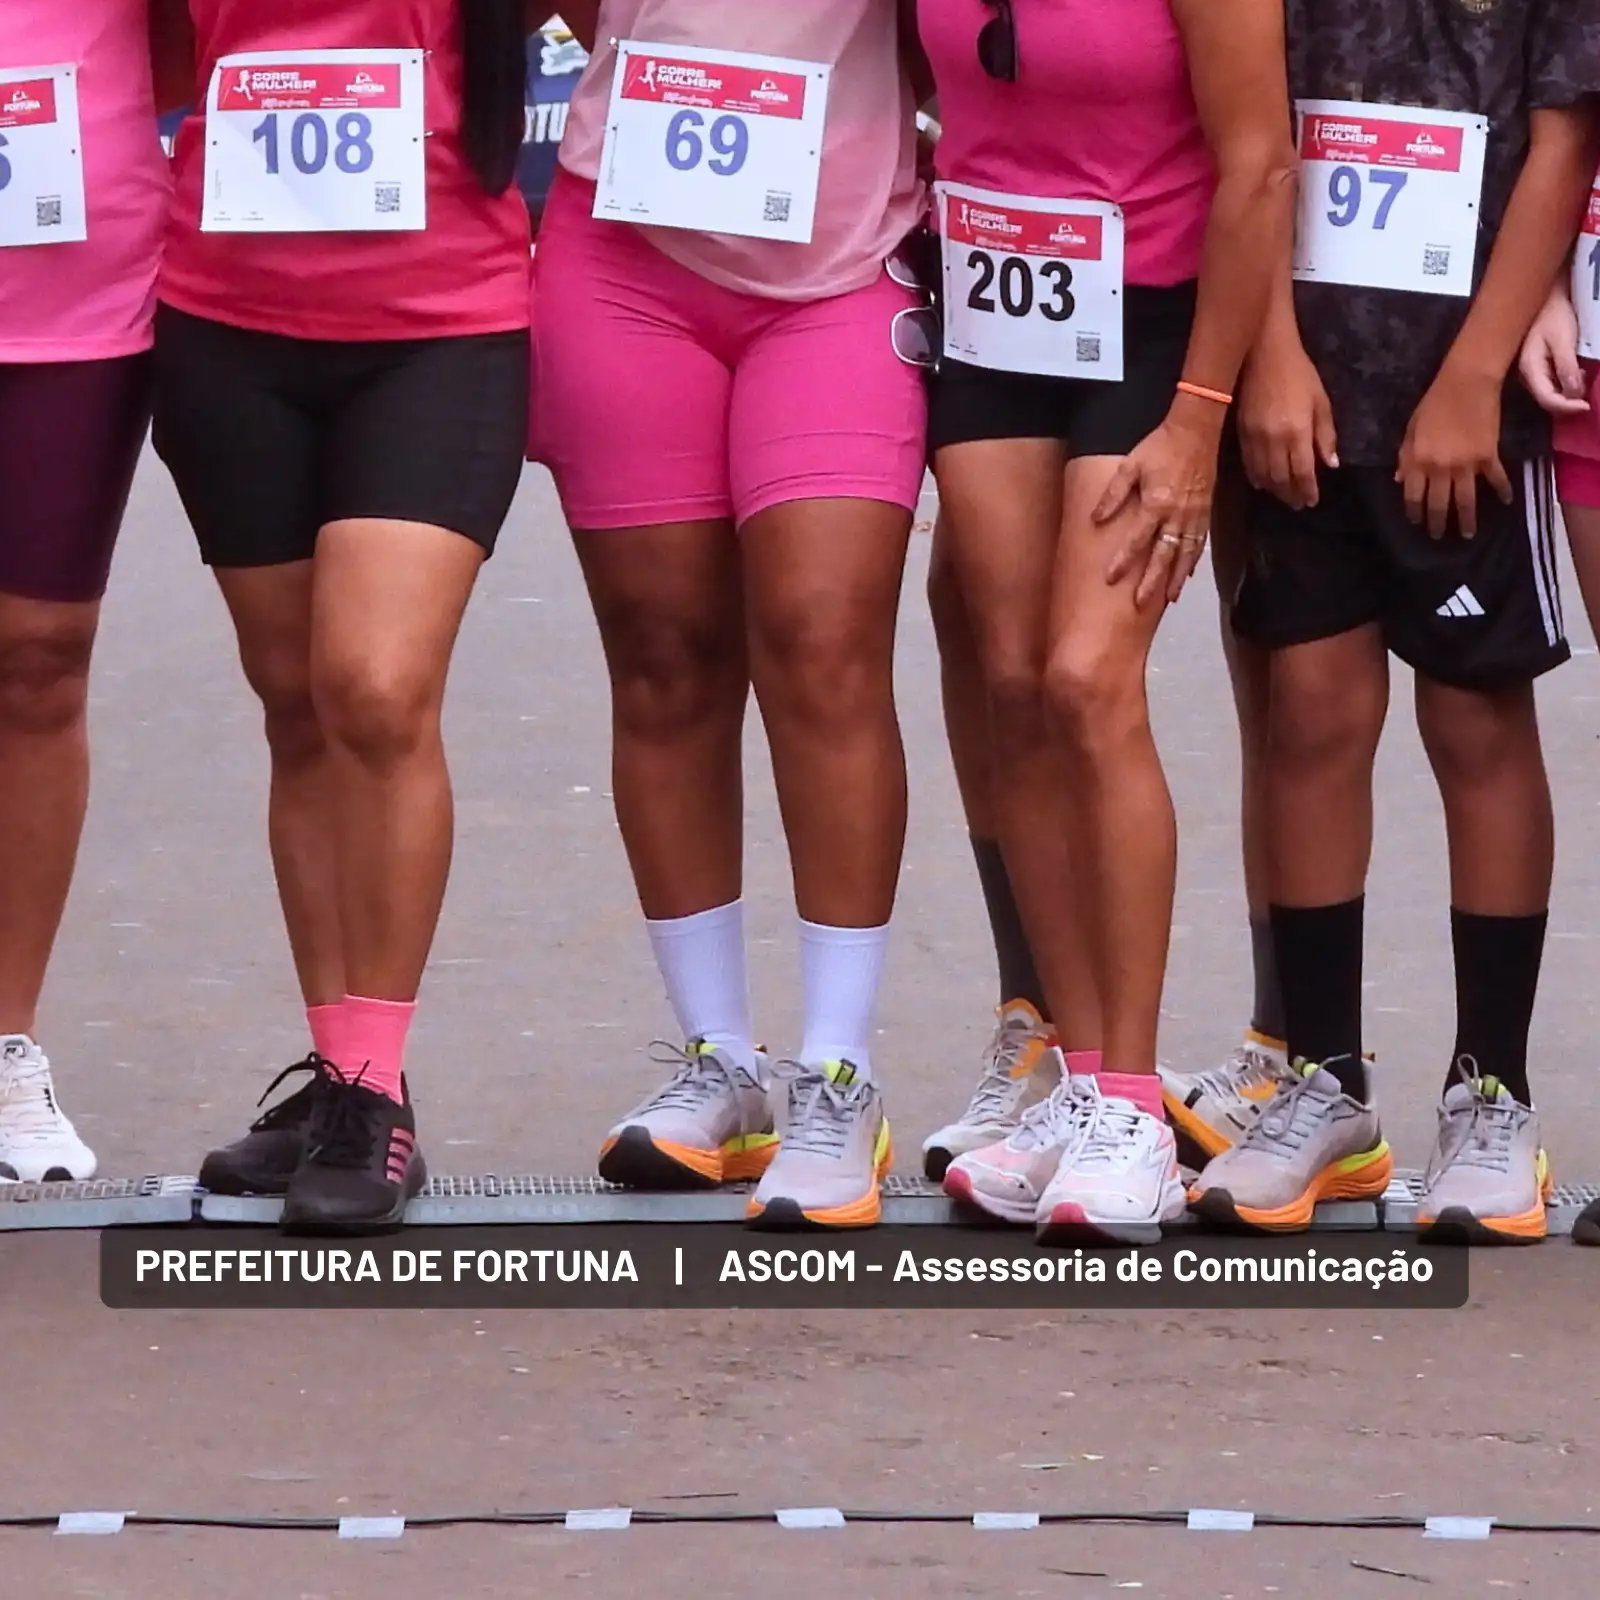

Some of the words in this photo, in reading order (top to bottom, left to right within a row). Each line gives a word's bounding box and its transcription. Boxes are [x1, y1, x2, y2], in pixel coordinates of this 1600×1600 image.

[252, 112, 374, 175] 108
[665, 109, 749, 176] 69
[1327, 165, 1408, 230] 97
[967, 250, 1075, 322] 203
